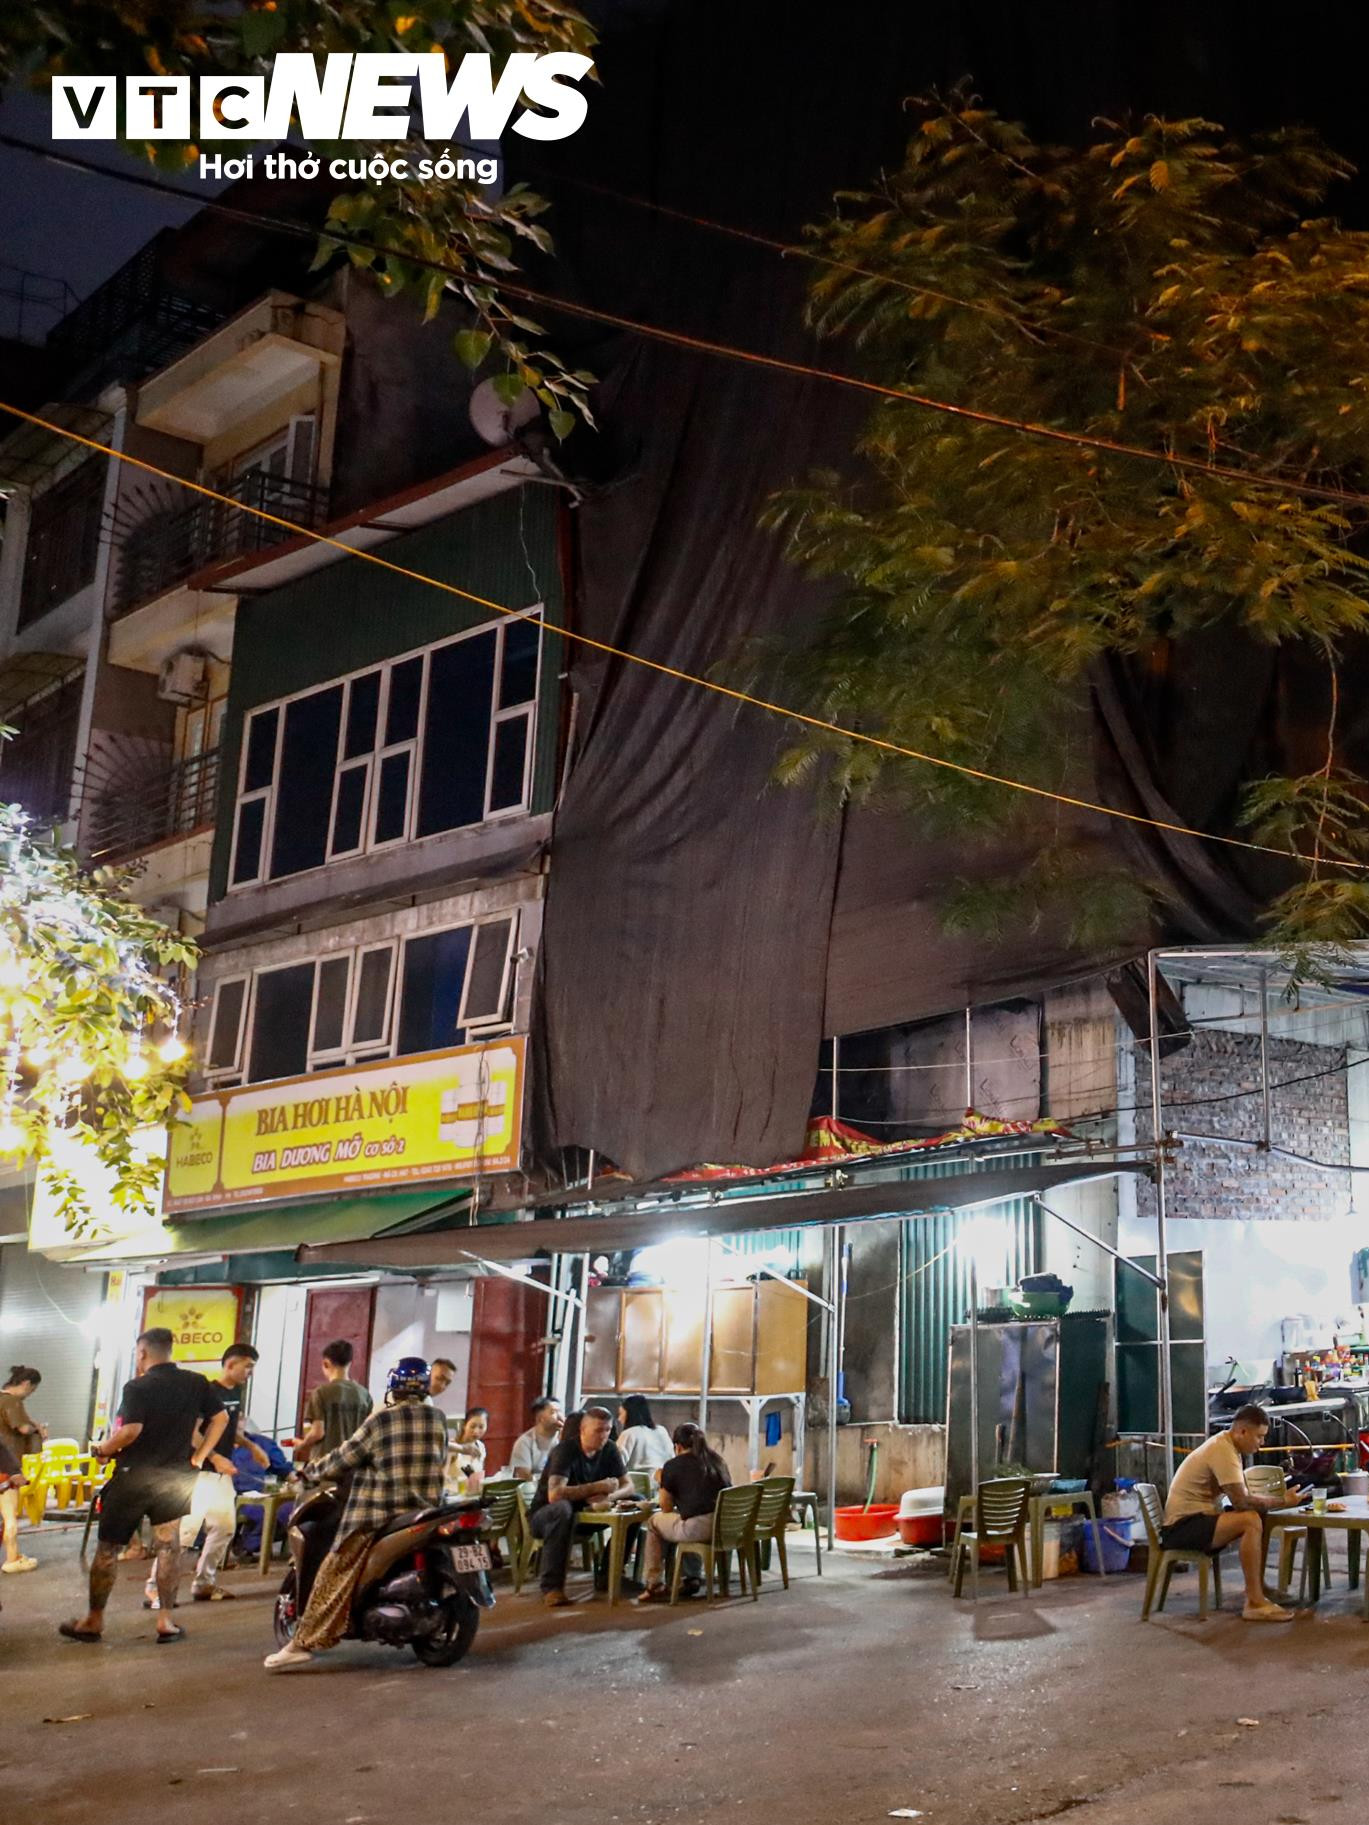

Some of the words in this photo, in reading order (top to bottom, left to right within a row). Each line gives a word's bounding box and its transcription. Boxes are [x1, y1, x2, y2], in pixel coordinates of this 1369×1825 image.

[256, 1108, 288, 1135] BIA
[334, 1086, 366, 1123] HÀ
[368, 1081, 410, 1124] NỘI
[176, 1151, 214, 1168] HABECO
[252, 1150, 277, 1174] BIA
[172, 1331, 223, 1344] ABECO
